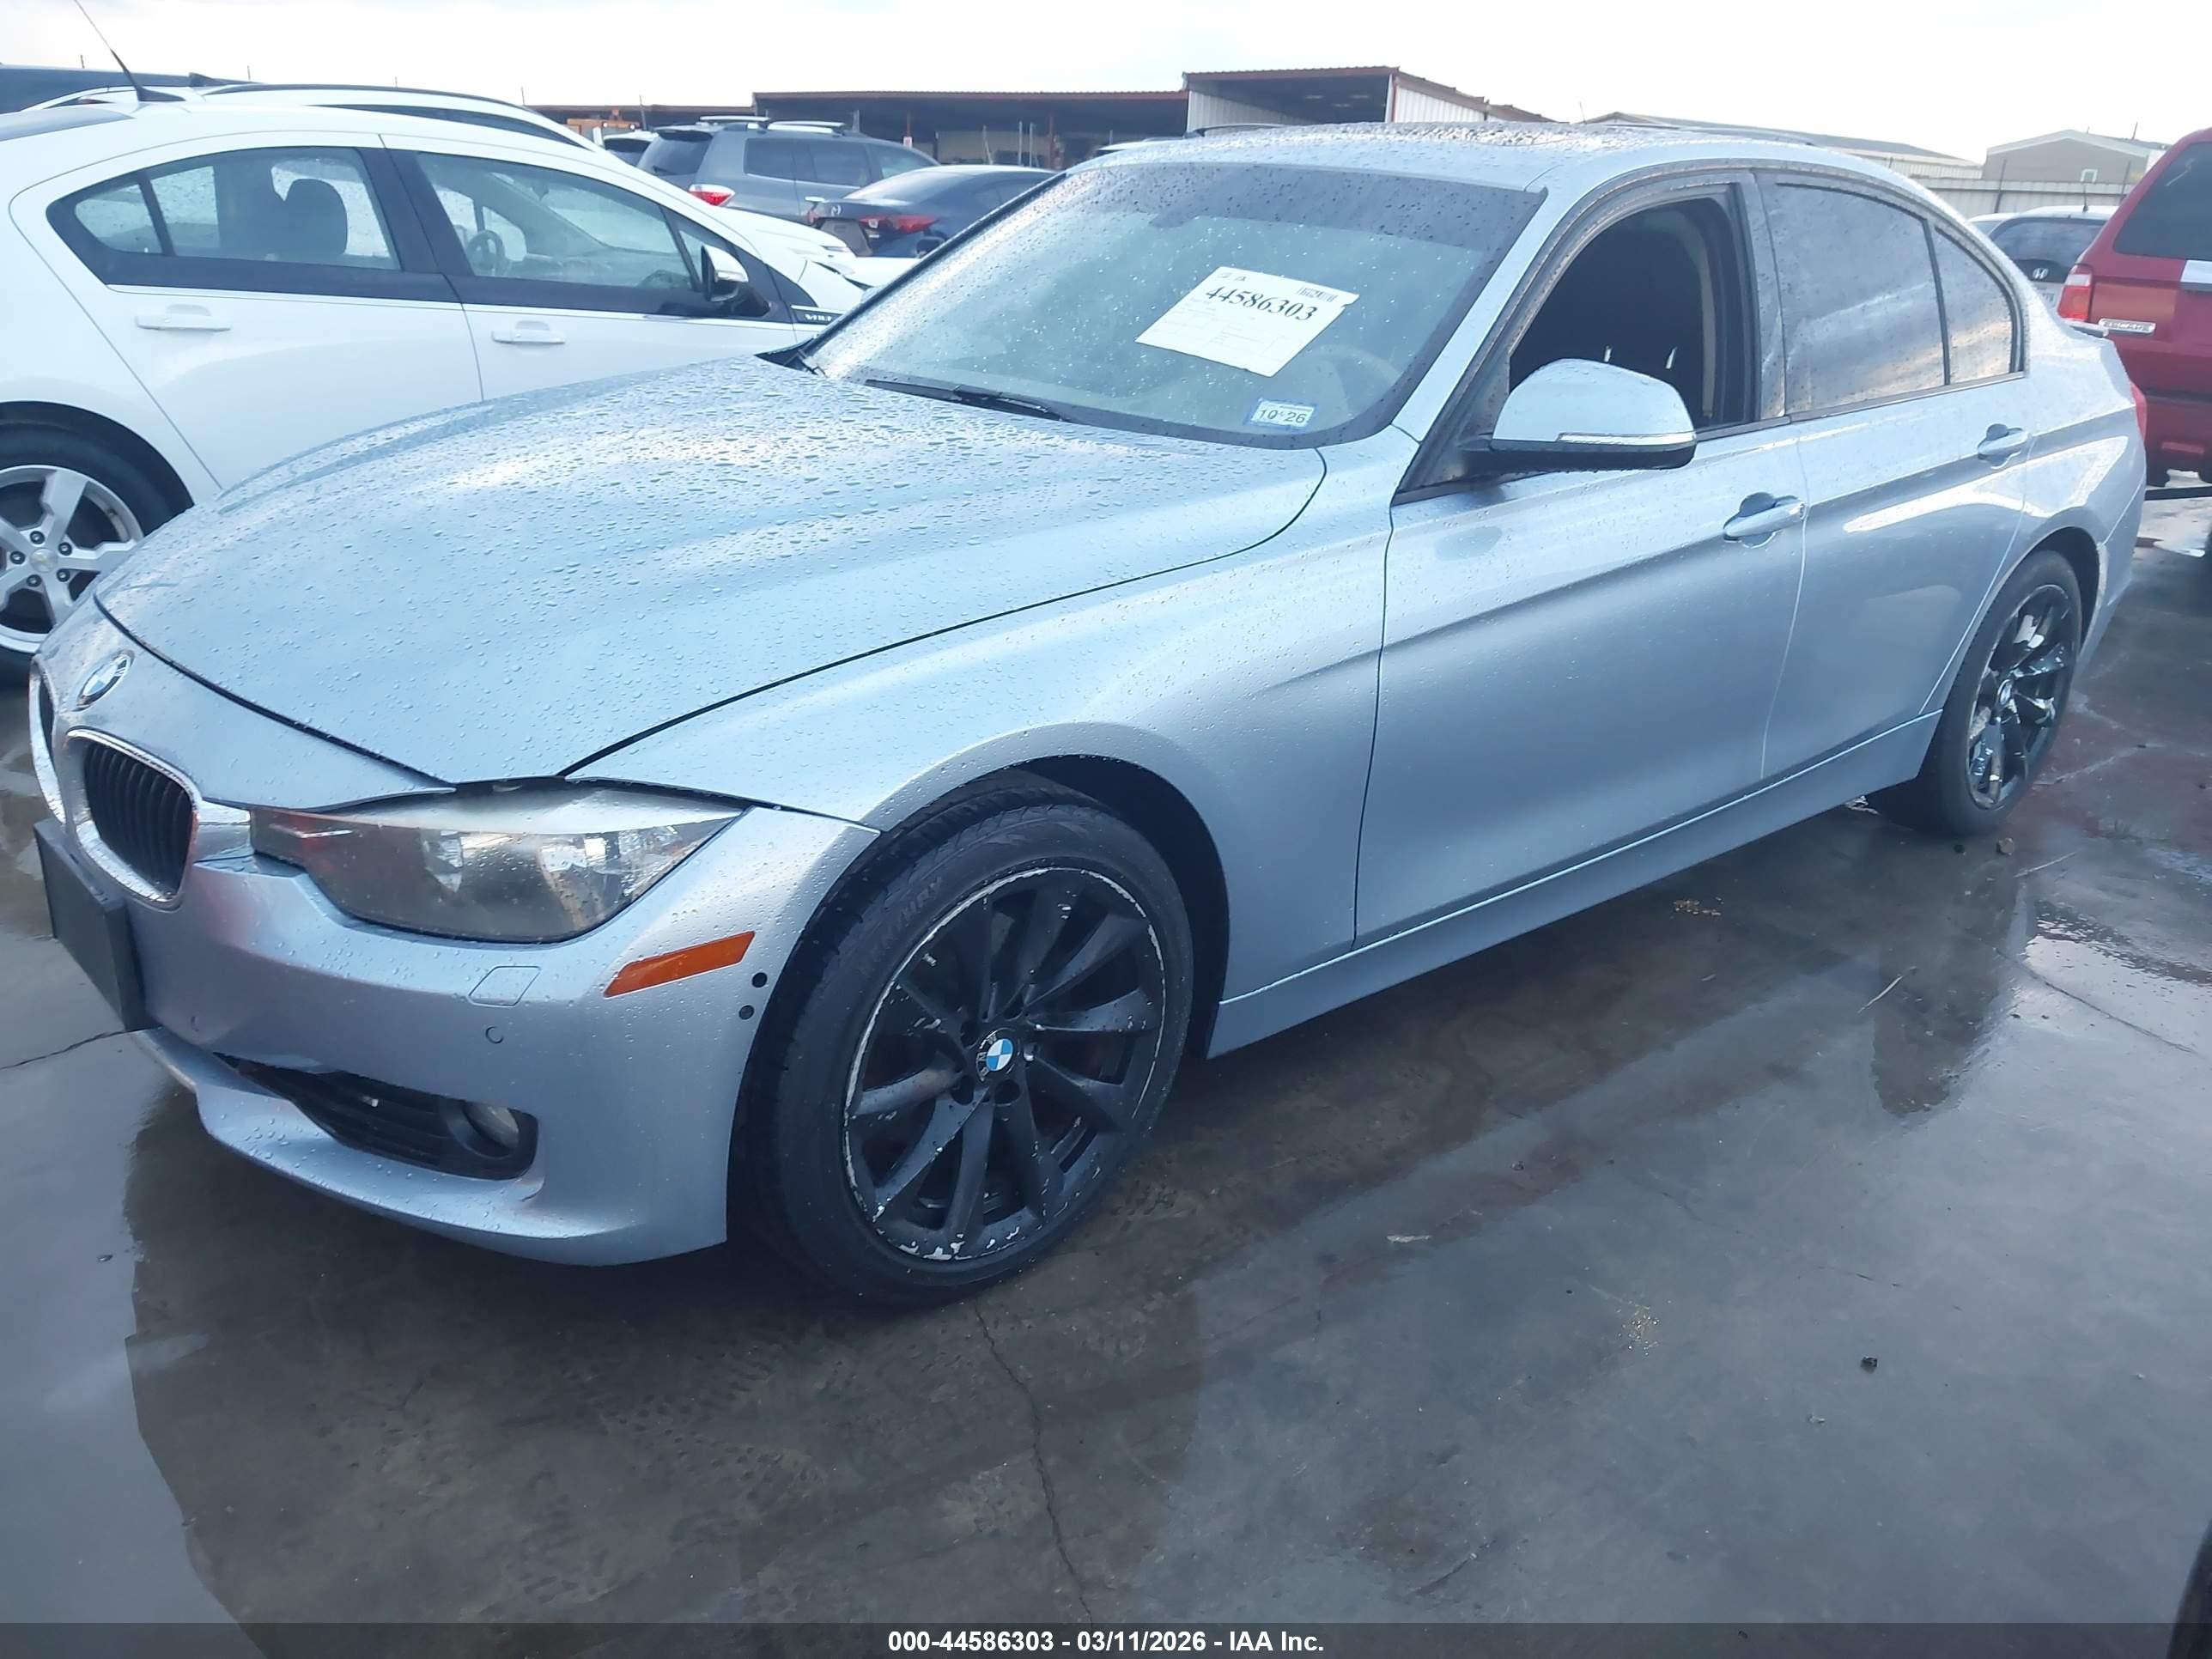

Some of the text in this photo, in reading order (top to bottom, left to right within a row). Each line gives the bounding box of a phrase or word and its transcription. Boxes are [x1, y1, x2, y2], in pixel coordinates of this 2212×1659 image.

[1206, 286, 1317, 321] 44586303
[1259, 410, 1308, 423] 10 26
